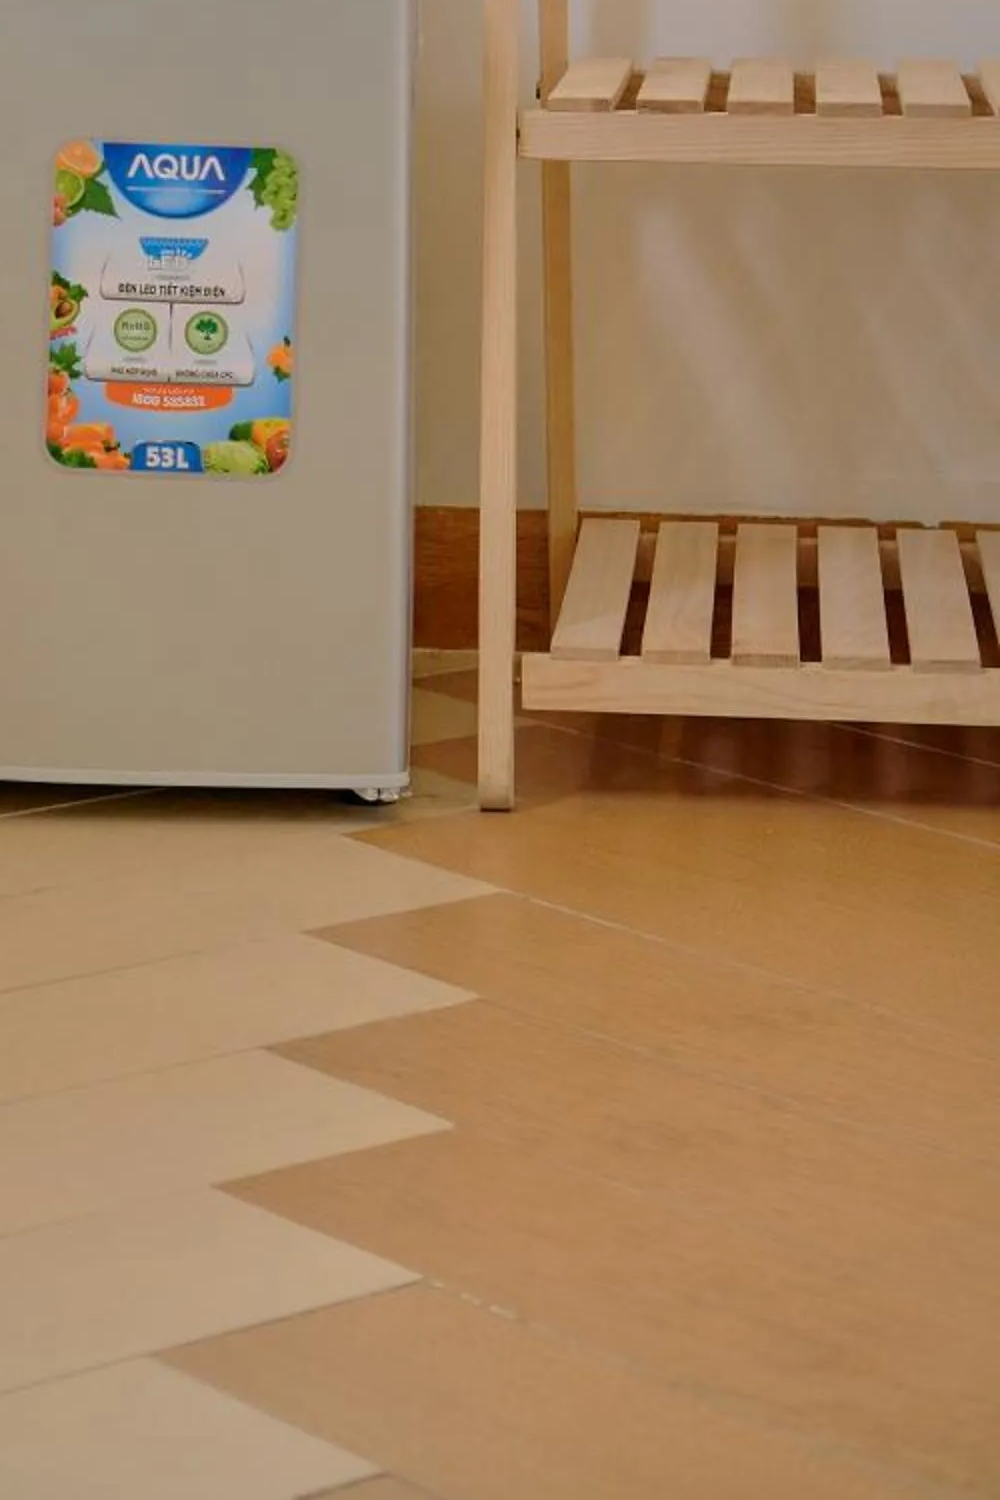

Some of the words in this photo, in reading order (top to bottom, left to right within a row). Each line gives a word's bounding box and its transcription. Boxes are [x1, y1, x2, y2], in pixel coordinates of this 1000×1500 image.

[127, 153, 225, 180] AQUA
[140, 284, 157, 295] LED
[146, 446, 189, 468] 53L
